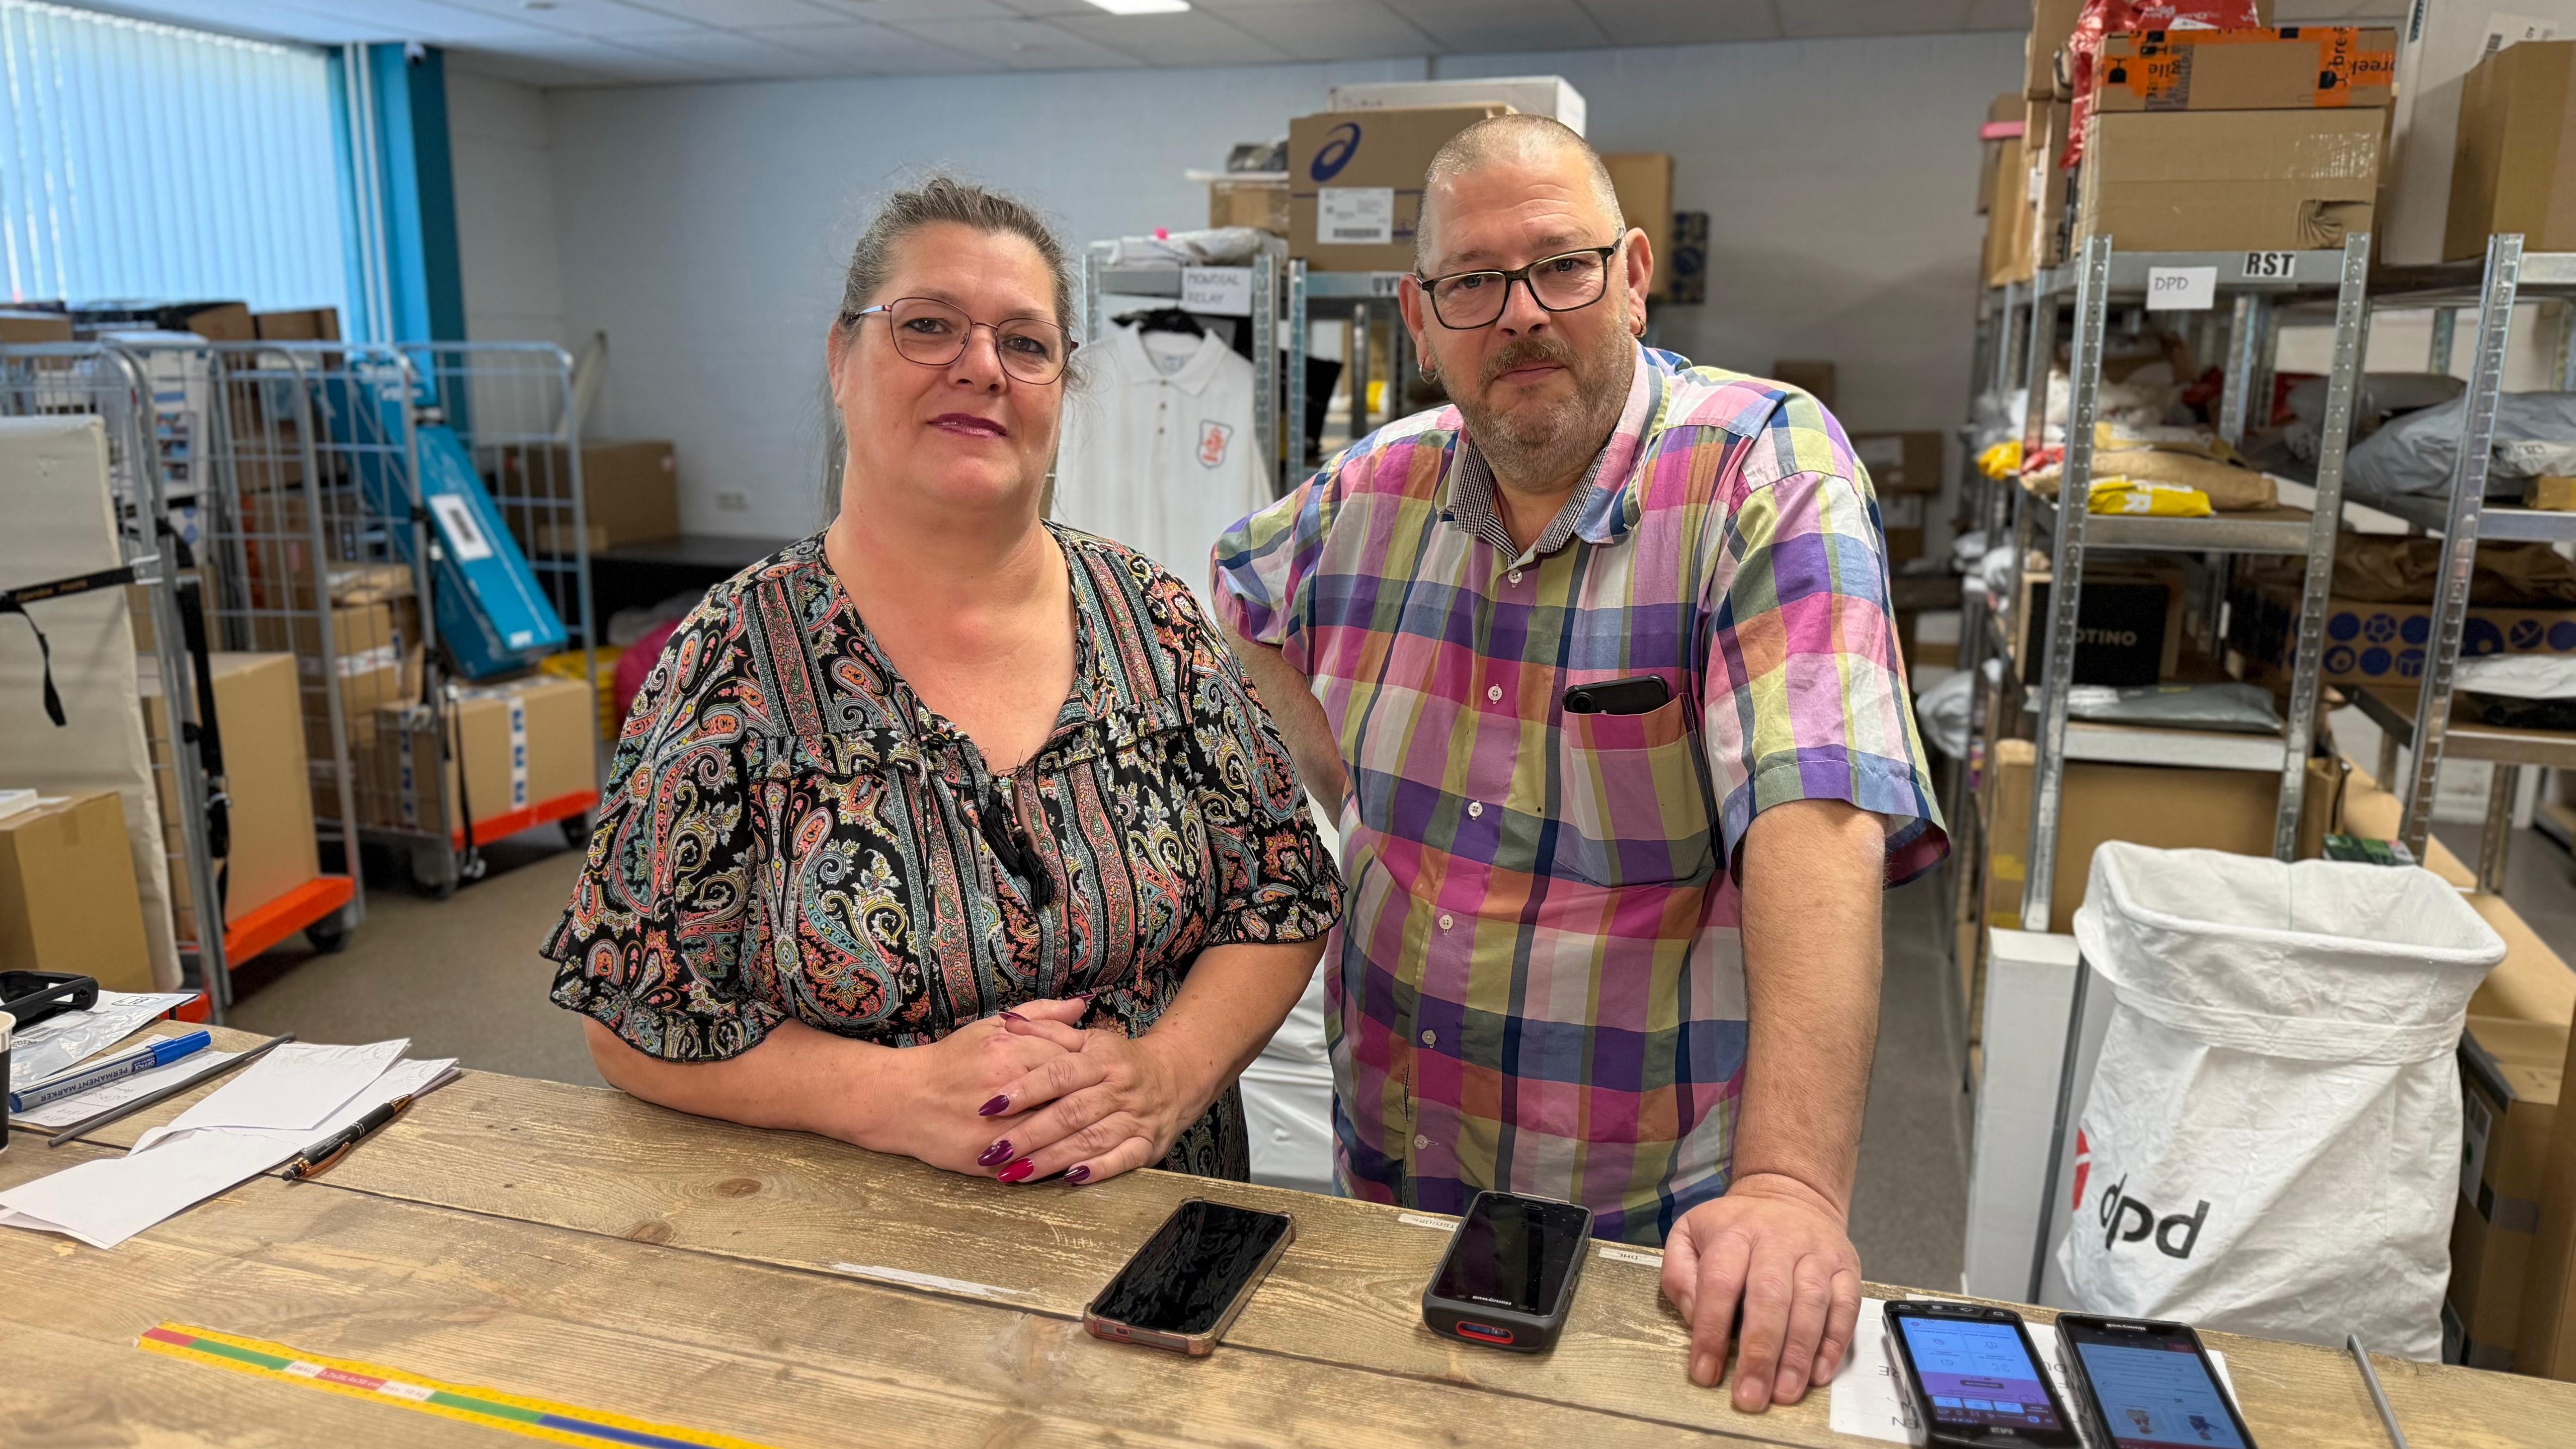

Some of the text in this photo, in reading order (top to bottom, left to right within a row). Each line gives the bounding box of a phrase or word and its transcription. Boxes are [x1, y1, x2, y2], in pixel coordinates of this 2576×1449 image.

[2245, 253, 2294, 276] RST
[2155, 277, 2188, 290] DPD
[2075, 629, 2137, 647] OTINO
[78, 1067, 128, 1090] PERMANENT
[41, 1084, 76, 1102] MARKER
[1413, 1218, 1459, 1229] TED/UPS
[2100, 1173, 2211, 1259] dpd
[1617, 1252, 1639, 1260] DHL
[290, 1364, 317, 1375] SMALL
[1990, 1426, 2015, 1434] M3
